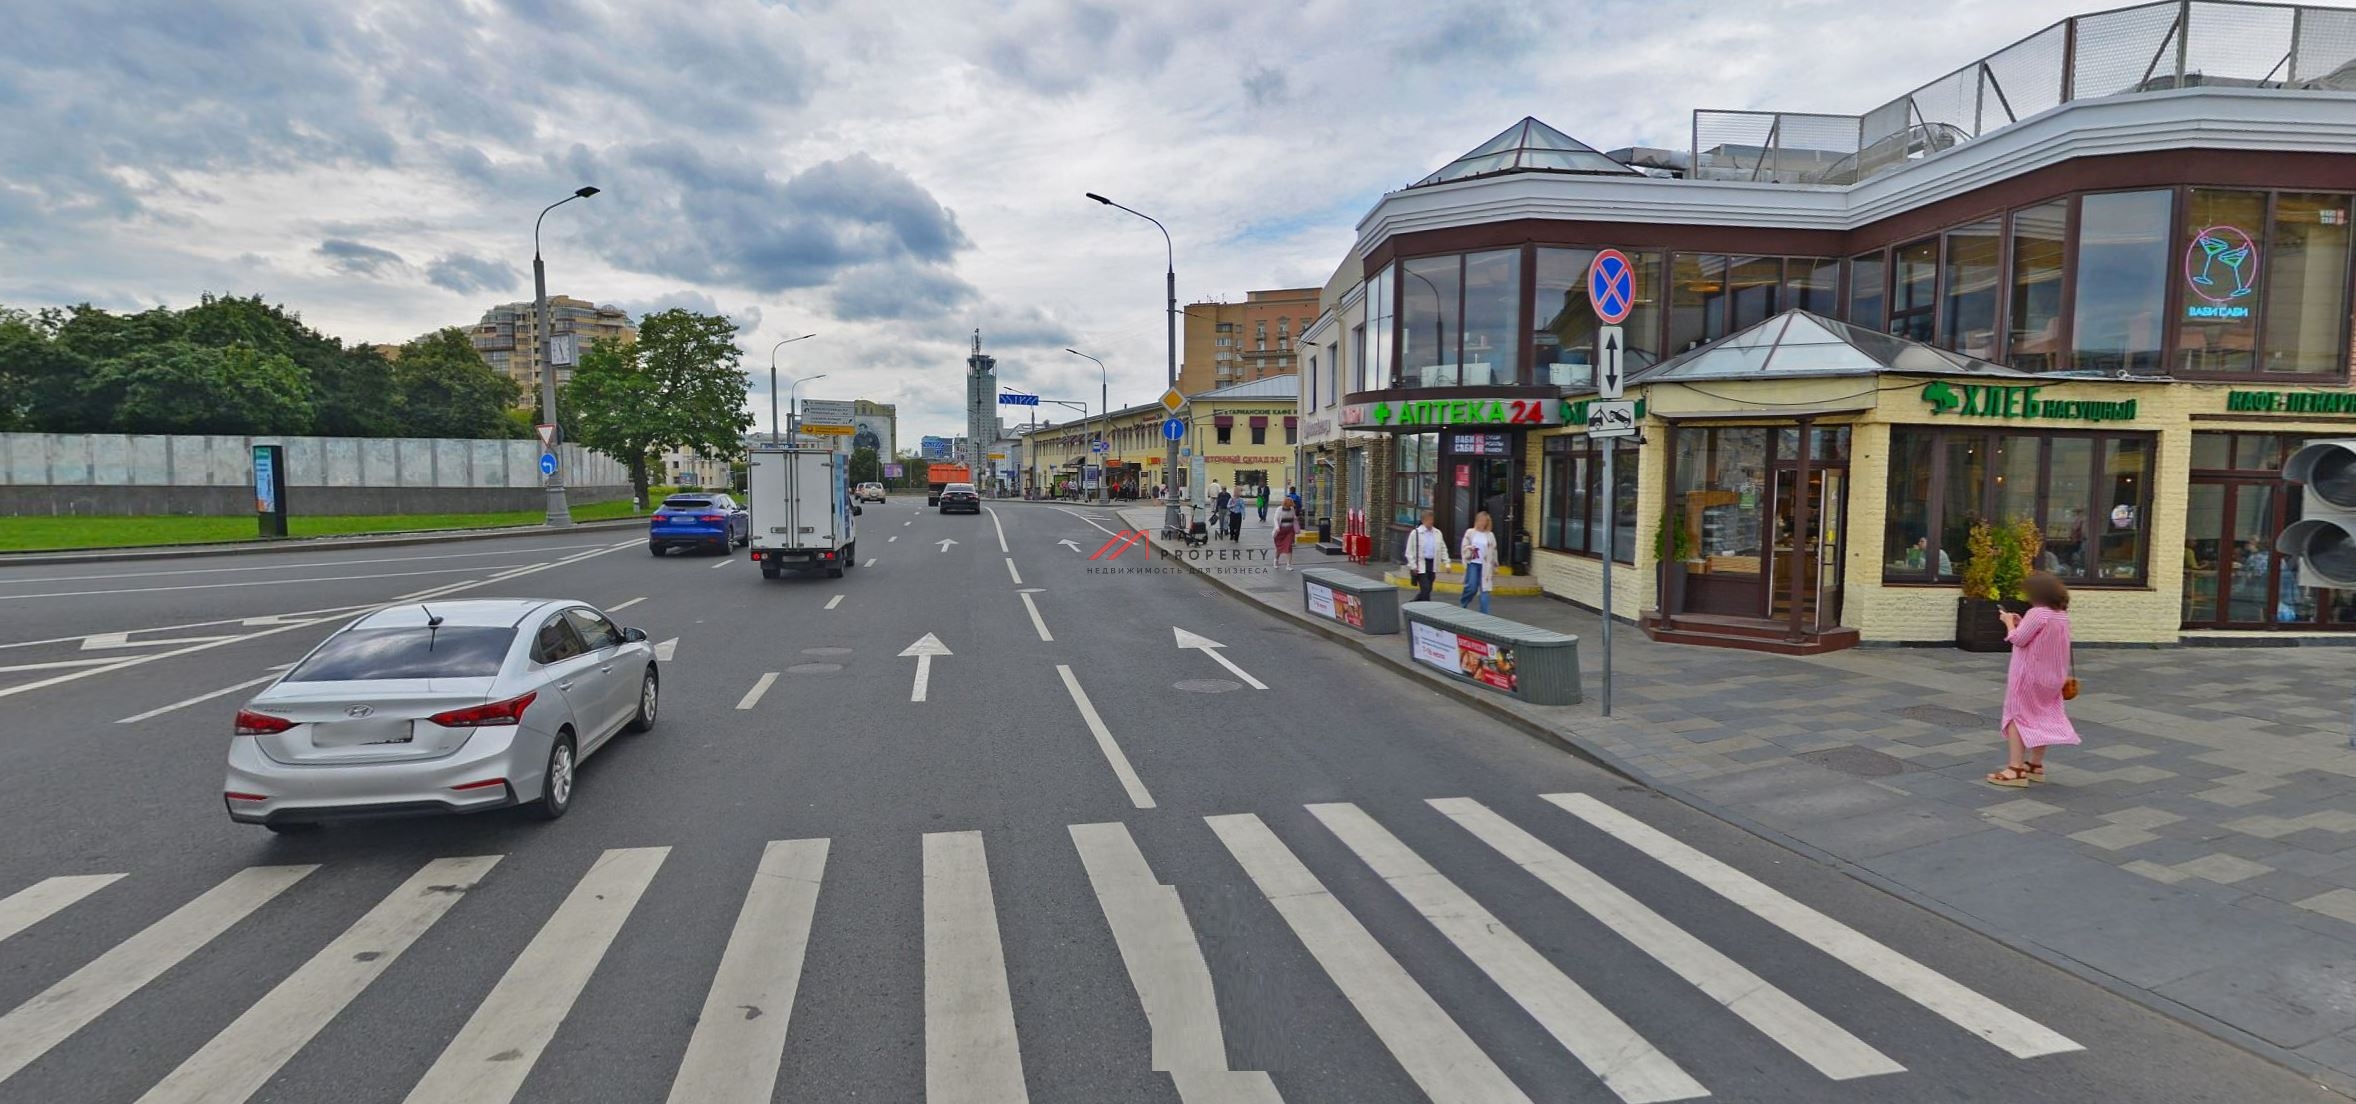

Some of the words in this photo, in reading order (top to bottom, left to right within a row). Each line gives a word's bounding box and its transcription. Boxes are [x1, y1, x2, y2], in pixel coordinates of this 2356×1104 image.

[1398, 400, 1505, 425] АПТЕКА
[1511, 400, 1544, 424] 24
[1961, 384, 2040, 418] ХЛЕБ
[2042, 399, 2137, 422] НАСУЩНЫЙ
